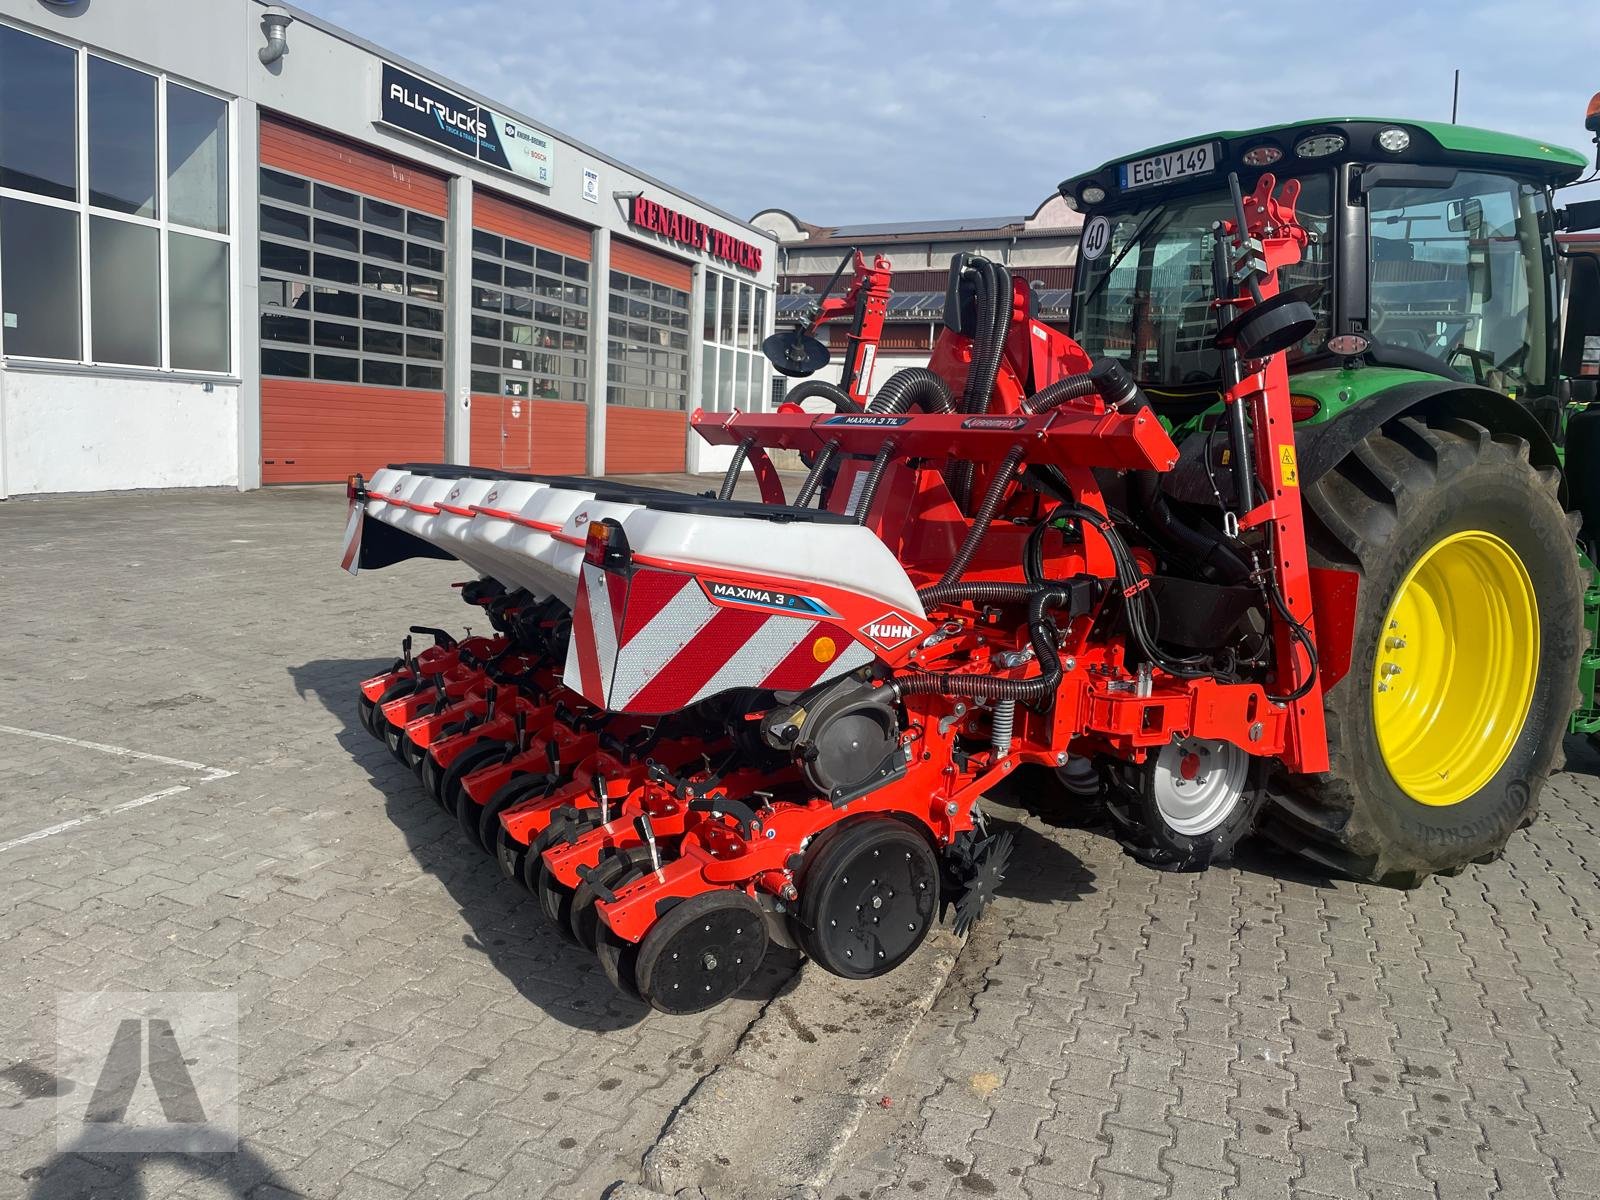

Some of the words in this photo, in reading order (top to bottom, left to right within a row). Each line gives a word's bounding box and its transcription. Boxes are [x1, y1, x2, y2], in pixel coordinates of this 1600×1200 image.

[390, 83, 487, 139] ALLTRUCKS
[1133, 161, 1154, 184] EG
[1163, 156, 1173, 177] V
[1176, 149, 1207, 175] 149
[634, 196, 709, 252] RENAULT
[712, 228, 762, 273] TRUCKS
[1086, 222, 1105, 252] 40
[845, 416, 876, 424] MAXIMA
[878, 417, 884, 425] 3
[714, 584, 771, 602] MAXIMA
[775, 594, 785, 605] 3
[788, 598, 795, 606] e
[869, 624, 913, 638] KUHN
